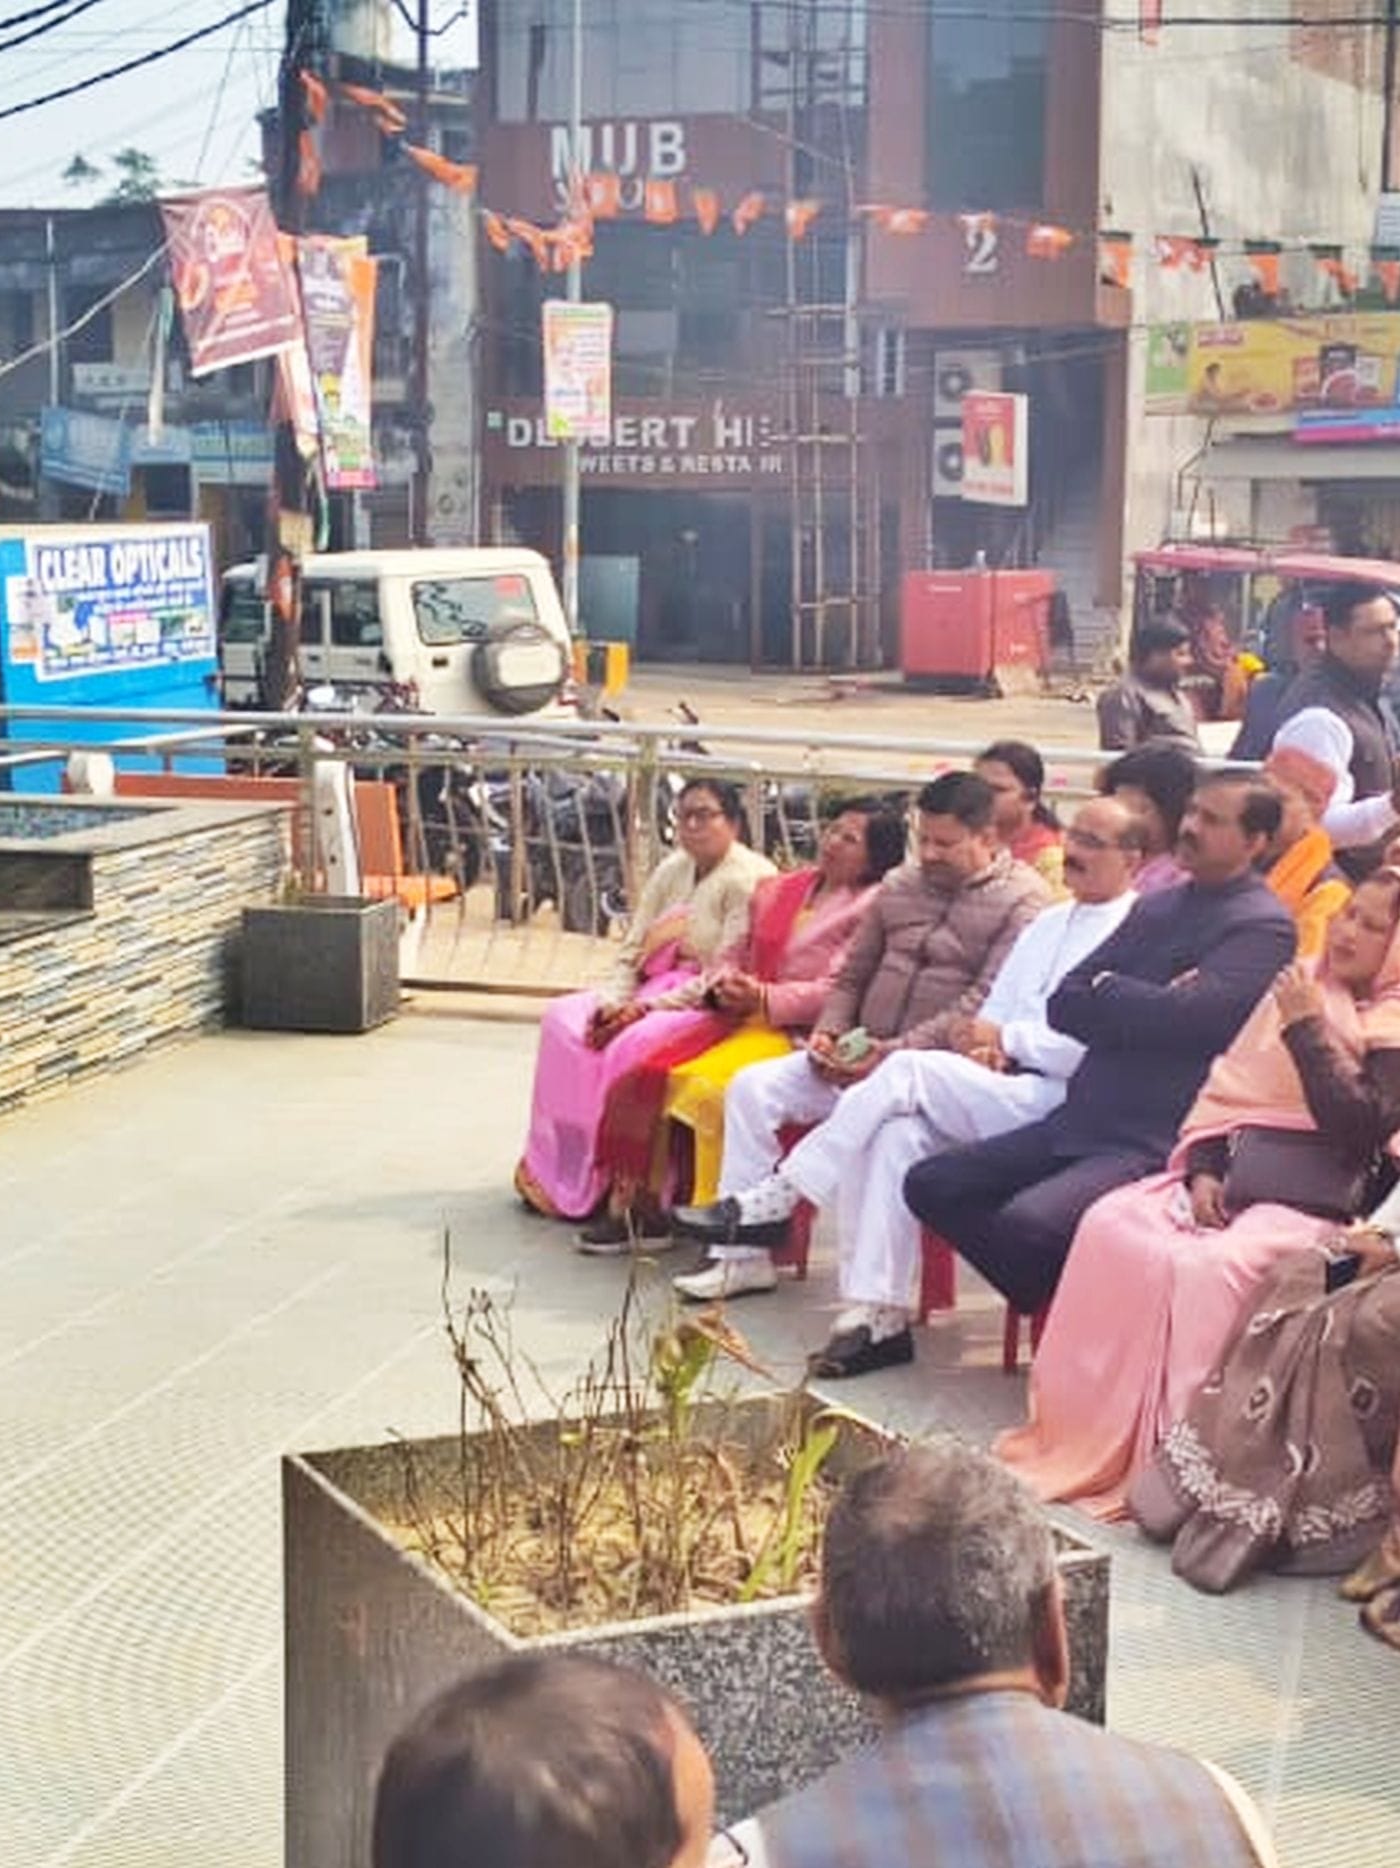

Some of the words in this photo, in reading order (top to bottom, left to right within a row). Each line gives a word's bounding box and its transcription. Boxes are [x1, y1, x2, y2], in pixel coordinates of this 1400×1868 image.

[552, 121, 686, 178] MUB
[507, 415, 696, 447] DEERT
[578, 455, 655, 473] WEETS
[39, 546, 107, 592] CLEAR
[109, 538, 204, 587] OPTICALS
